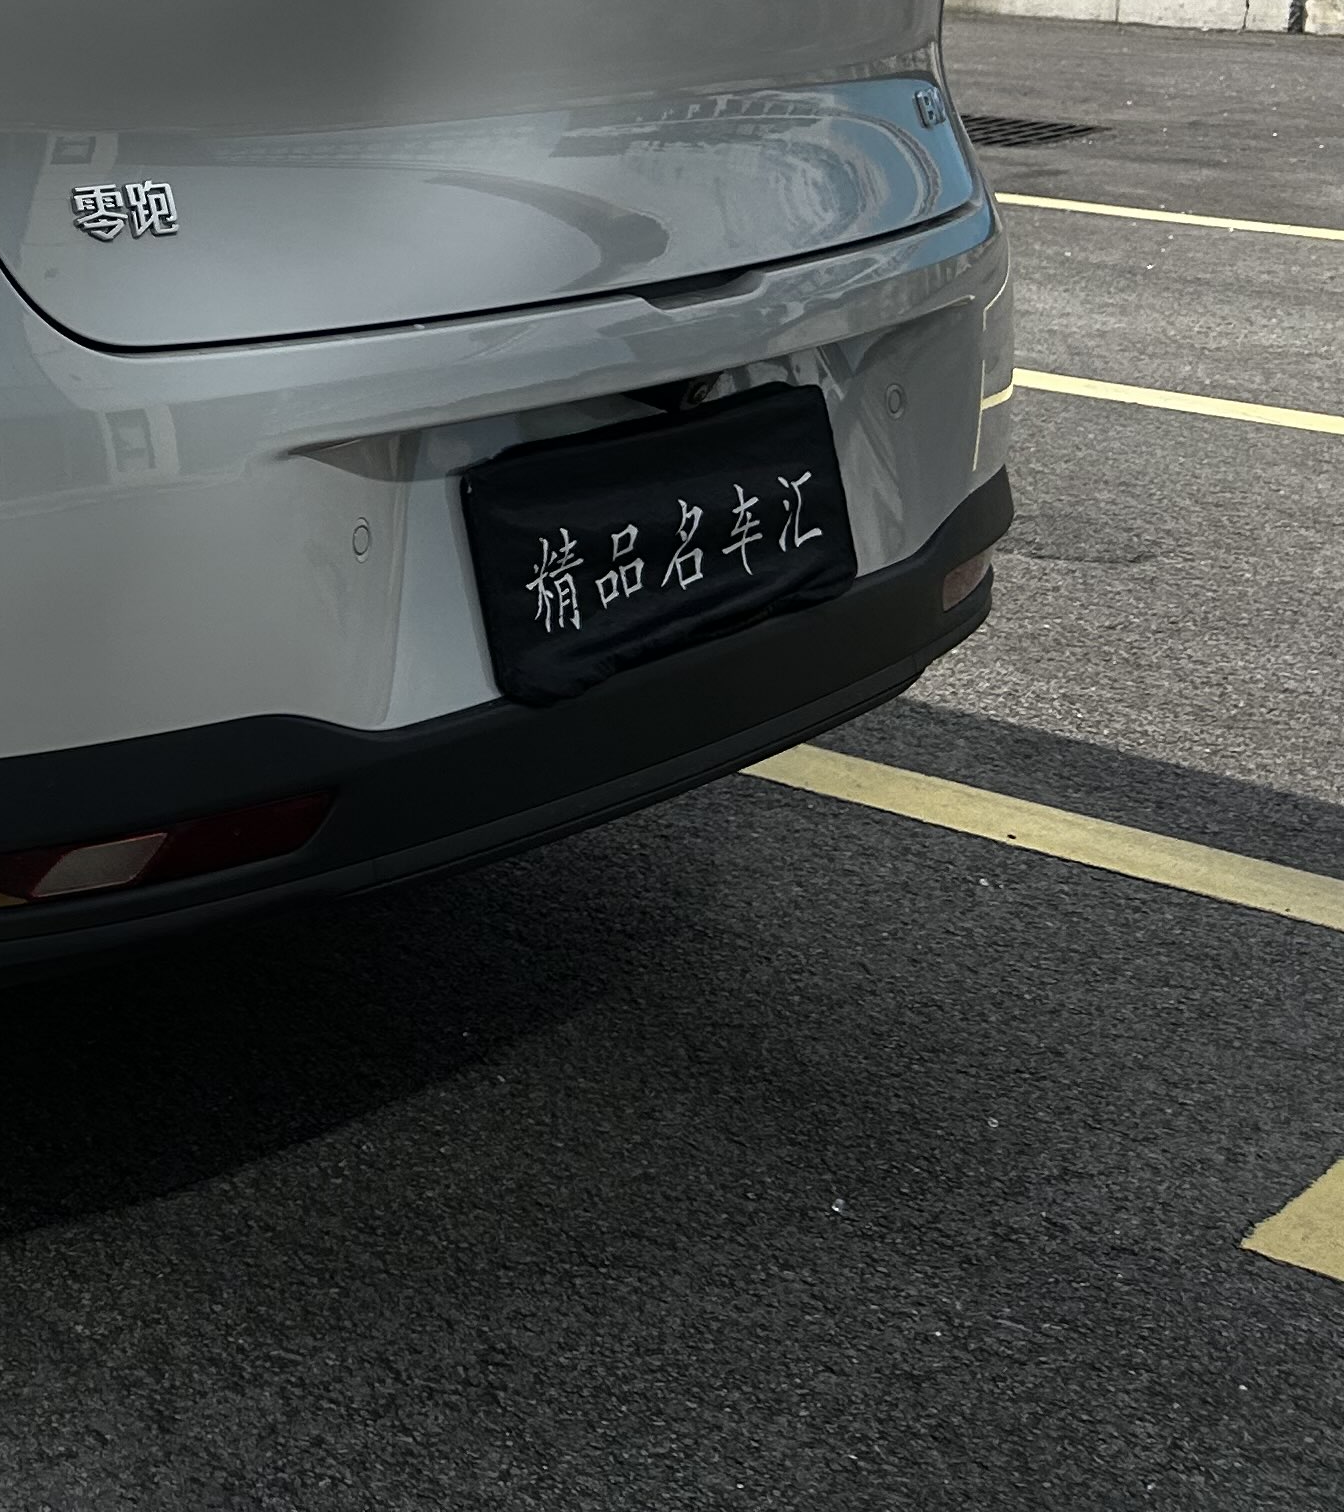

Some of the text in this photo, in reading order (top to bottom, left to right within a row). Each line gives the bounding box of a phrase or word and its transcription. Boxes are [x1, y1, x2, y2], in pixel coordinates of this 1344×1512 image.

[72, 180, 180, 242] 零跑
[526, 470, 823, 633] 精品名车汇
